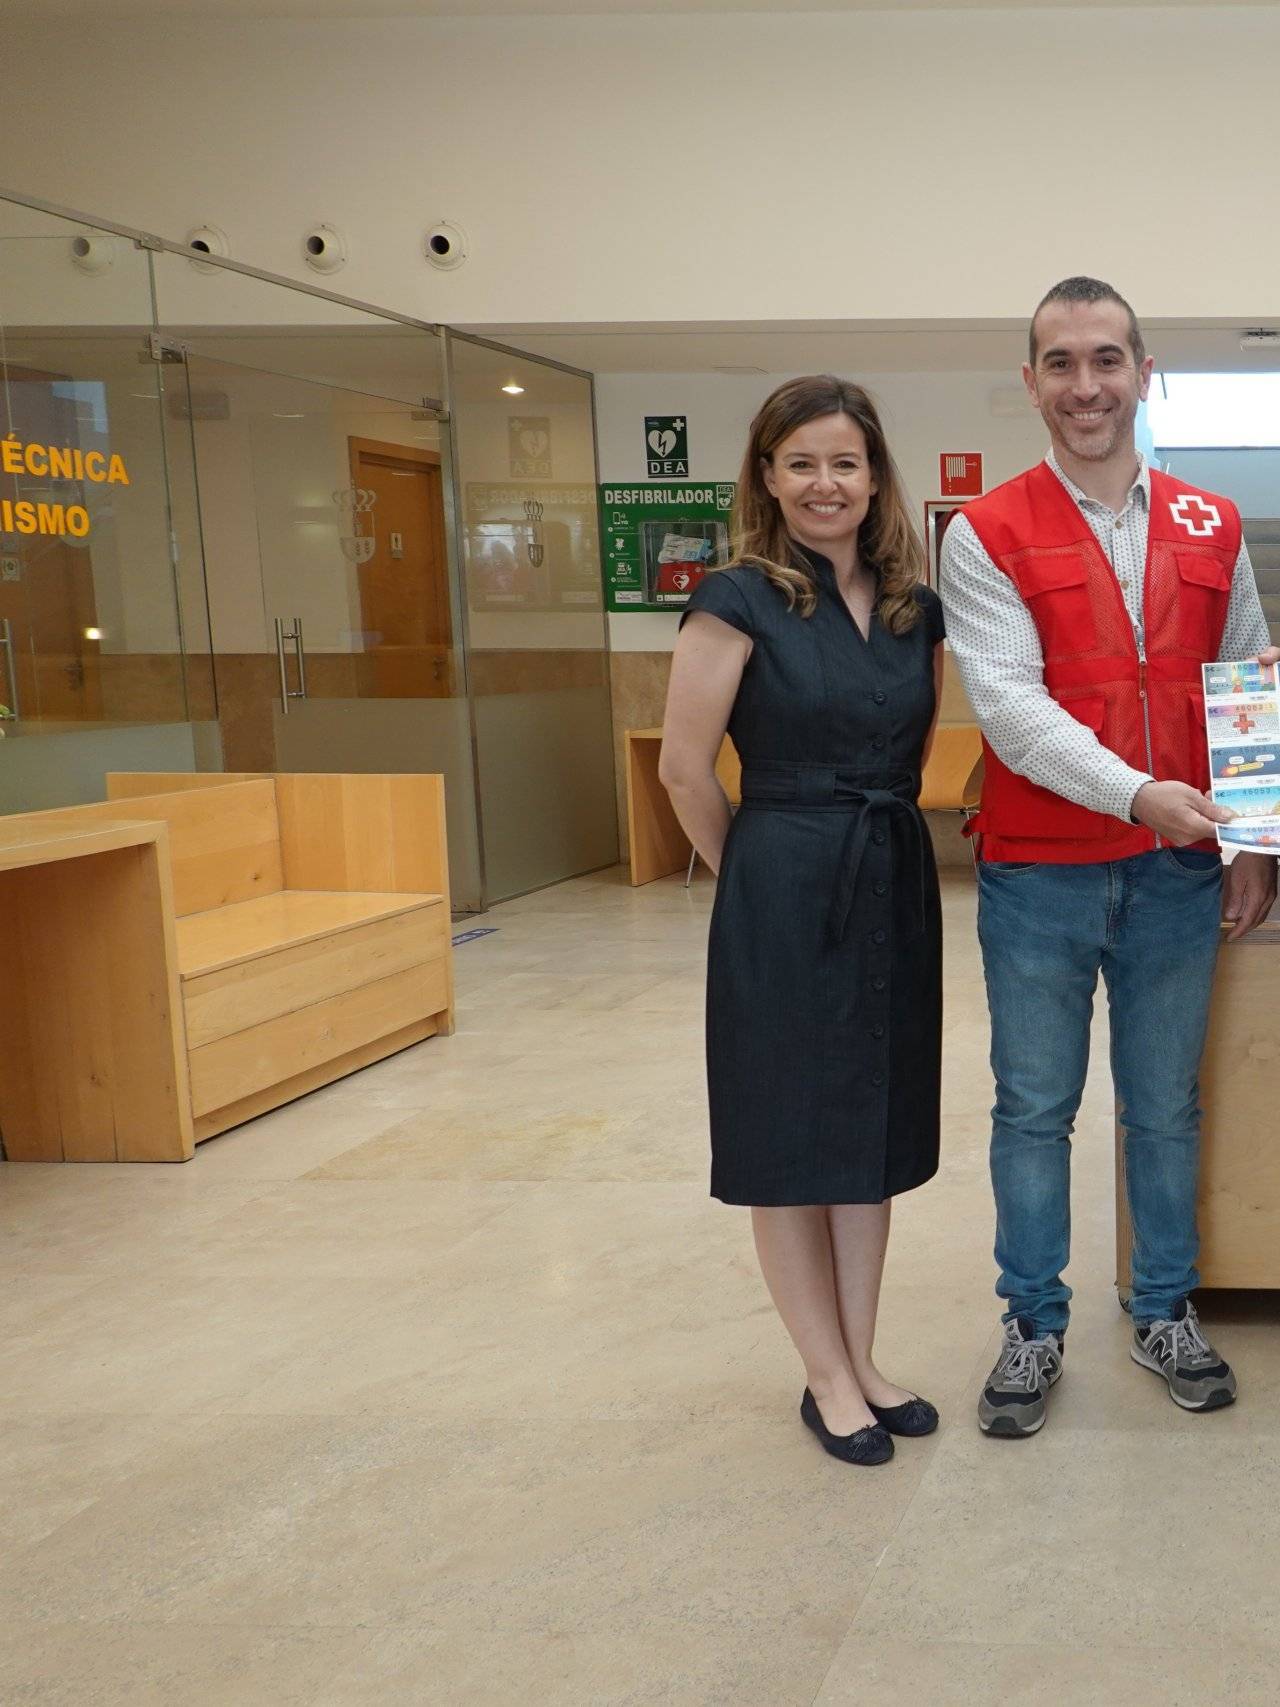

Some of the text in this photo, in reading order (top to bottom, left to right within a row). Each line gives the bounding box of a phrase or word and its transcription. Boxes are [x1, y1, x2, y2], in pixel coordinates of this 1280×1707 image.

[650, 461, 686, 473] DEA
[605, 489, 715, 504] DESFIBRILADOR
[0, 500, 90, 537] ISMO
